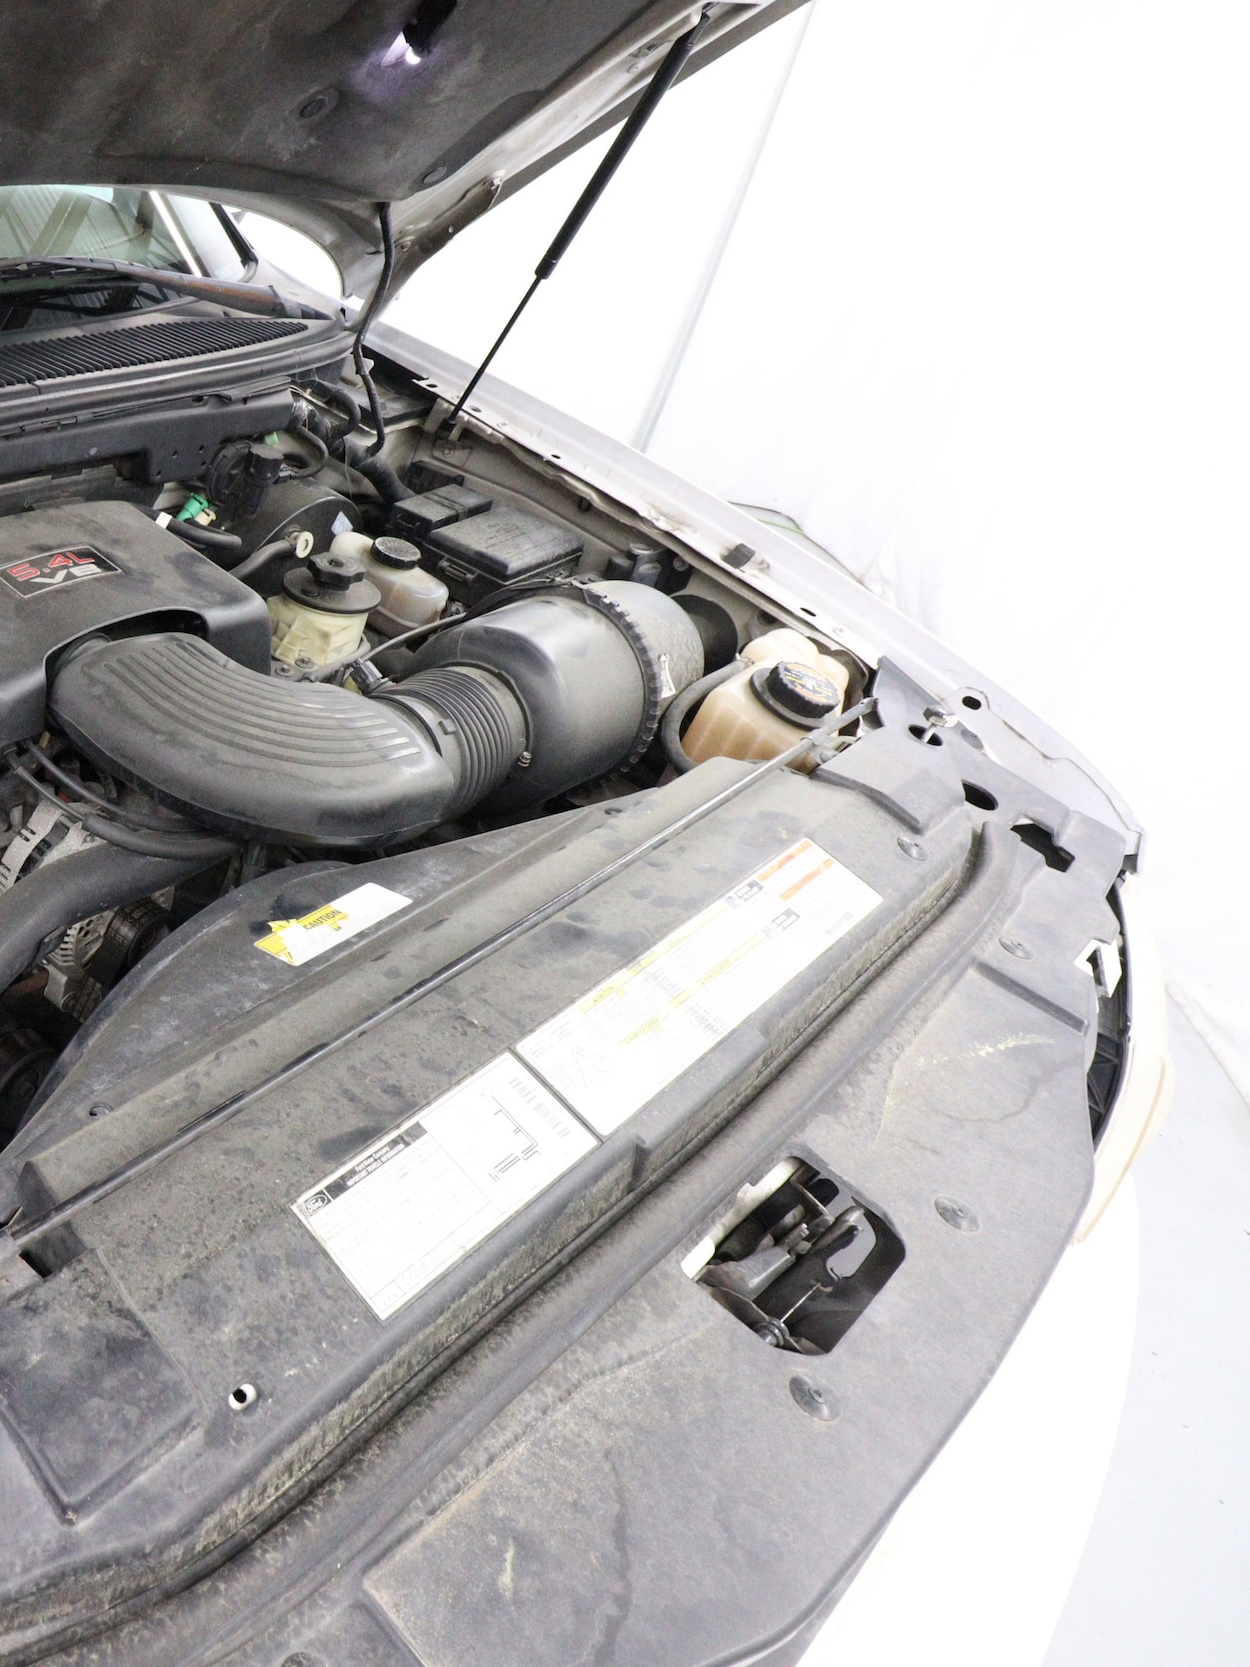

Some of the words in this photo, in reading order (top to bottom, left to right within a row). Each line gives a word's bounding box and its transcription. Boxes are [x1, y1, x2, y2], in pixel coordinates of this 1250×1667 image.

[7, 552, 95, 581] 5.4L
[30, 563, 102, 584] V8
[303, 908, 343, 931] CAUTION
[306, 1196, 323, 1213] Ford
